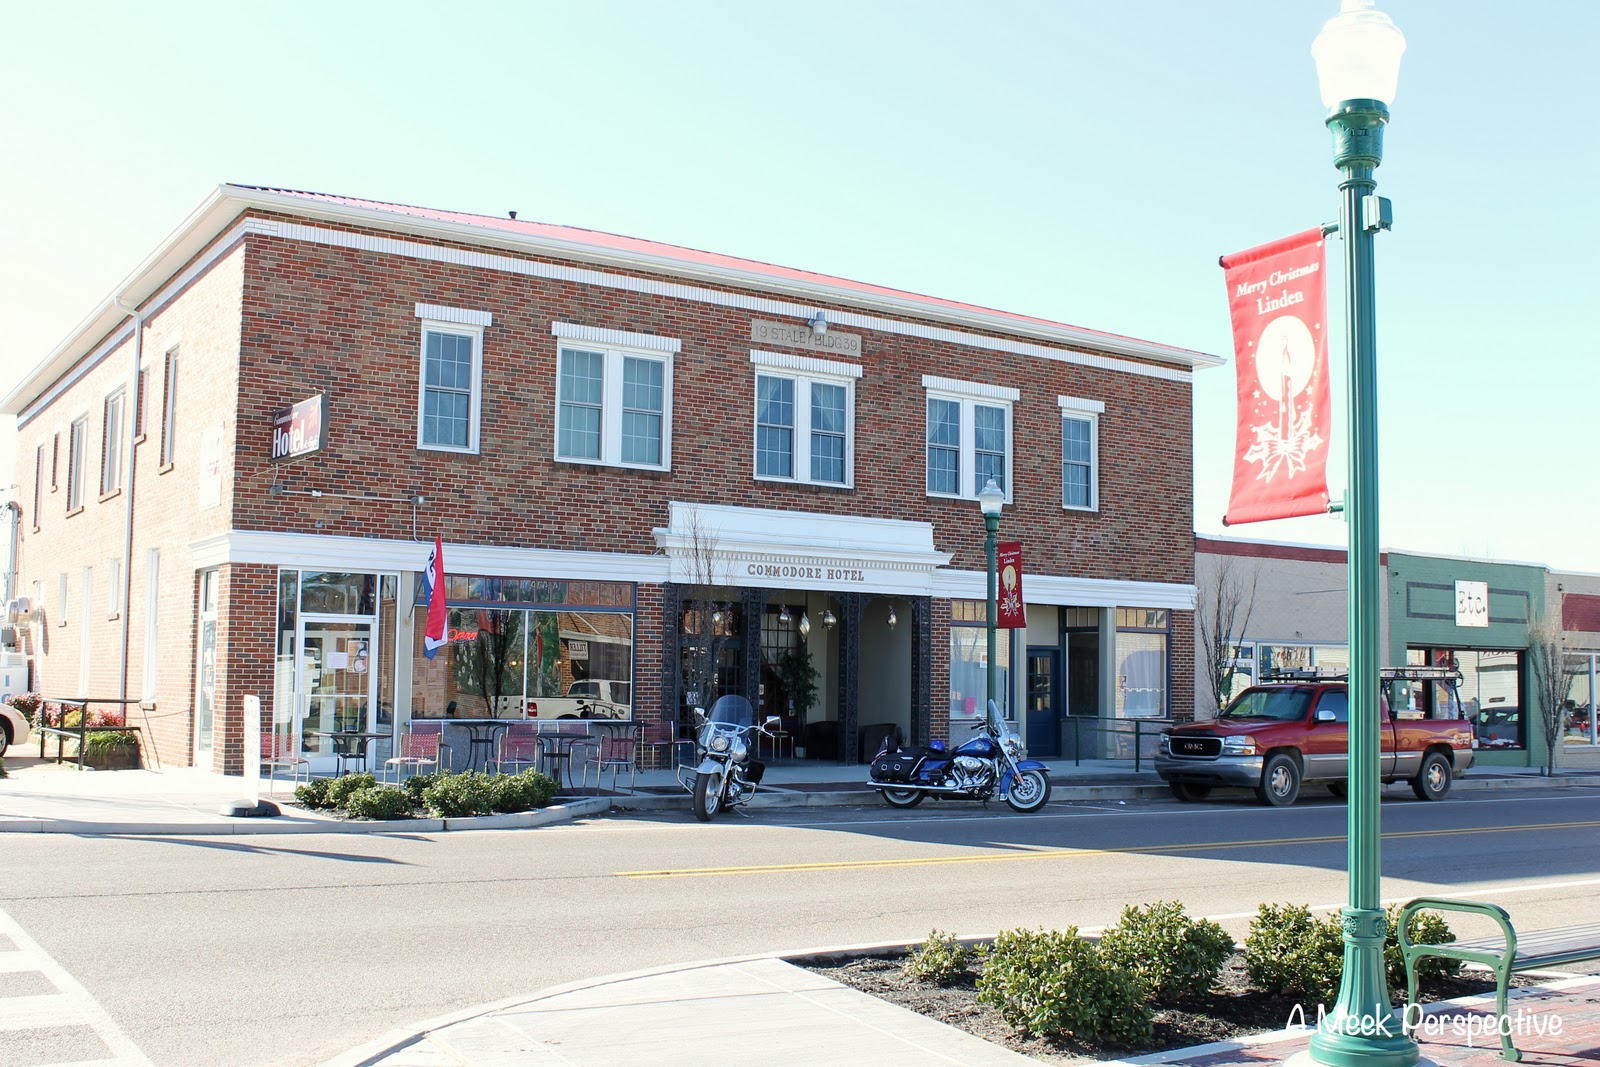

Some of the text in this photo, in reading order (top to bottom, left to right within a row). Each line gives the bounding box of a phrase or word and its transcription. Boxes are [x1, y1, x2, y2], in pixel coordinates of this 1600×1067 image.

[1235, 262, 1320, 298] Merry Christmas
[1256, 289, 1304, 315] Linden
[771, 327, 813, 345] STALEY
[843, 338, 858, 351] 39
[272, 419, 305, 459] Hotel
[747, 564, 865, 581] COMMODORE HOTEL
